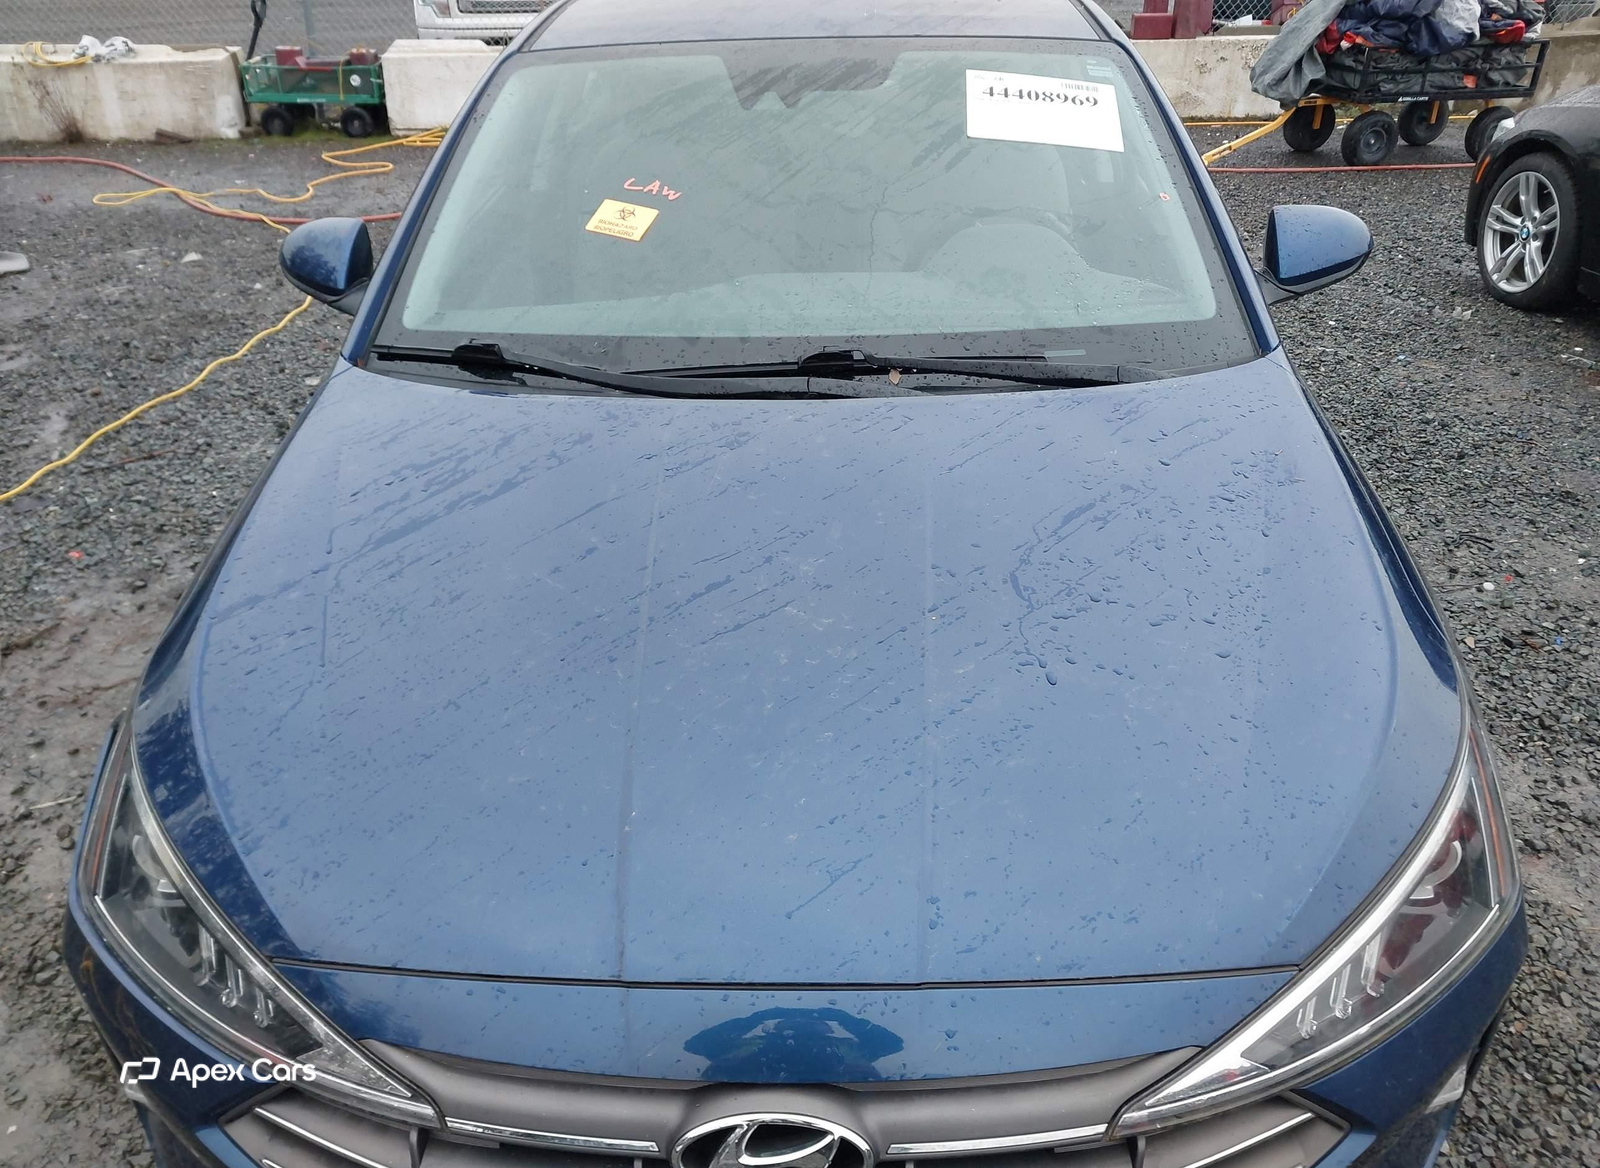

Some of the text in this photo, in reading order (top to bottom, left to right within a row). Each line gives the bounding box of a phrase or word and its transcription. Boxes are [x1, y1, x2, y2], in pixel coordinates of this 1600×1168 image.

[982, 86, 1099, 107] 44408969
[593, 225, 634, 237] BIOPELIGRO
[598, 219, 638, 231] BIOHAZARD
